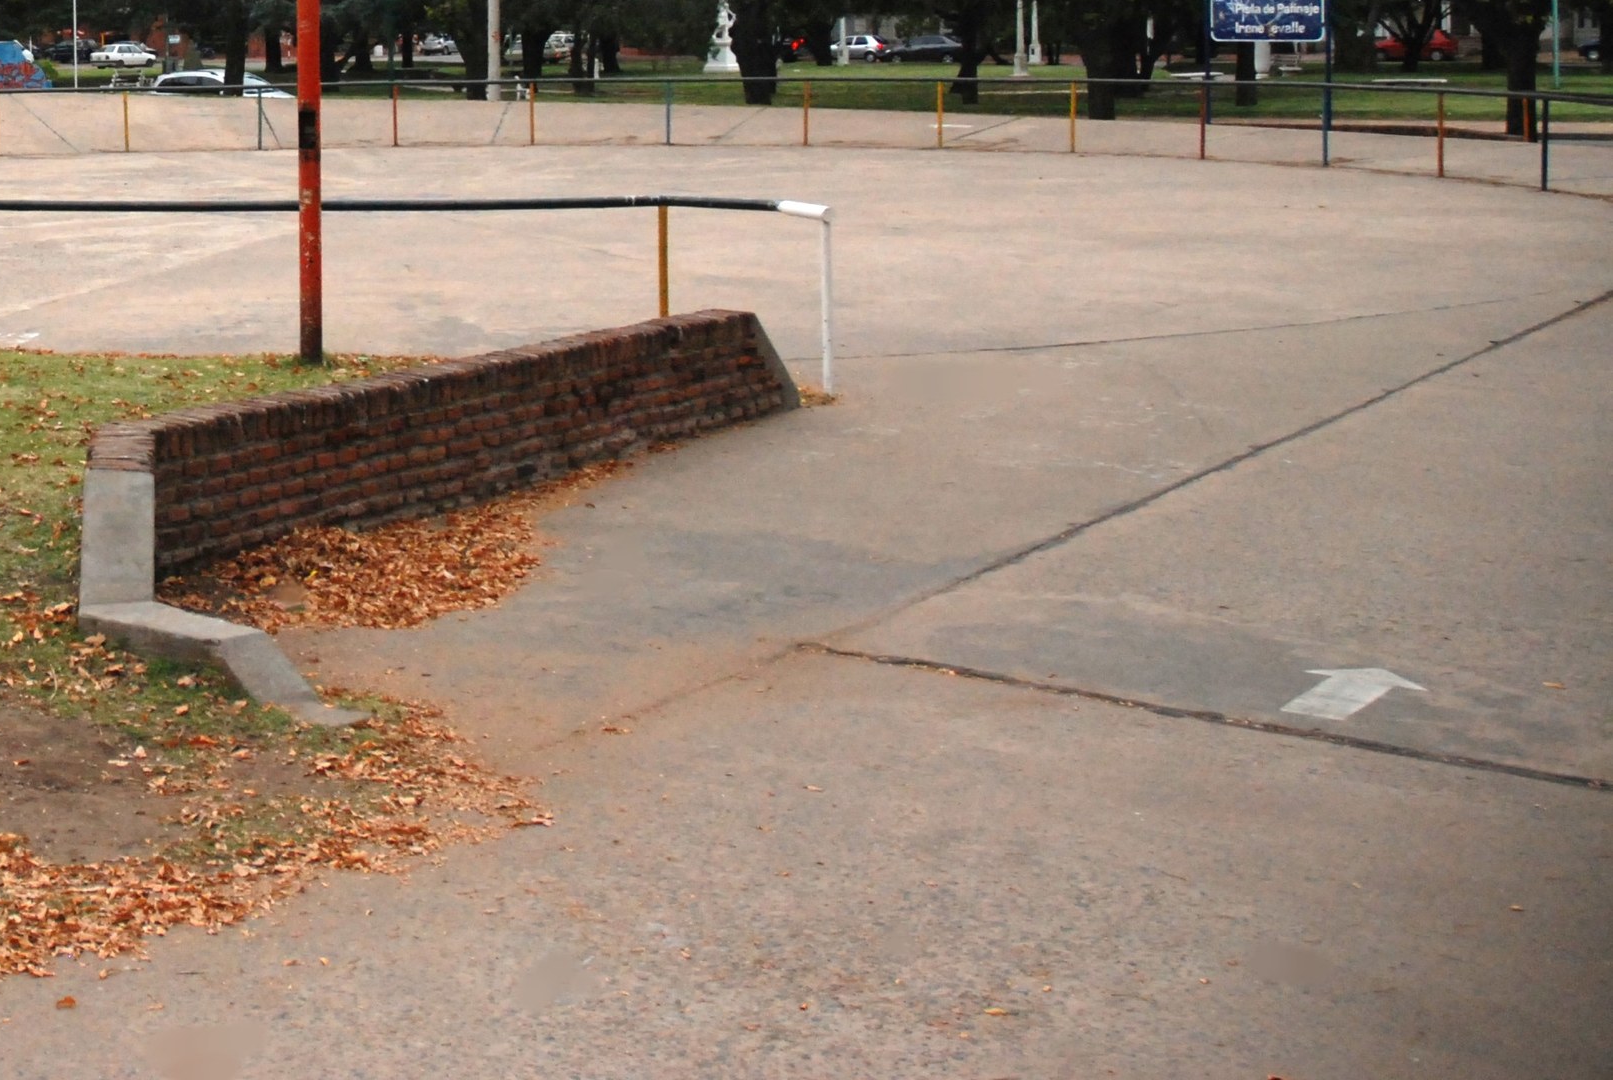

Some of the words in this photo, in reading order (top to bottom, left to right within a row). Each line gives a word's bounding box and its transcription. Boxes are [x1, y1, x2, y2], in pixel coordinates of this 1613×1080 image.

[1263, 3, 1276, 14] de
[1276, 3, 1320, 17] Patinaje
[1235, 21, 1265, 34] Irene
[1266, 21, 1306, 34] evalle
